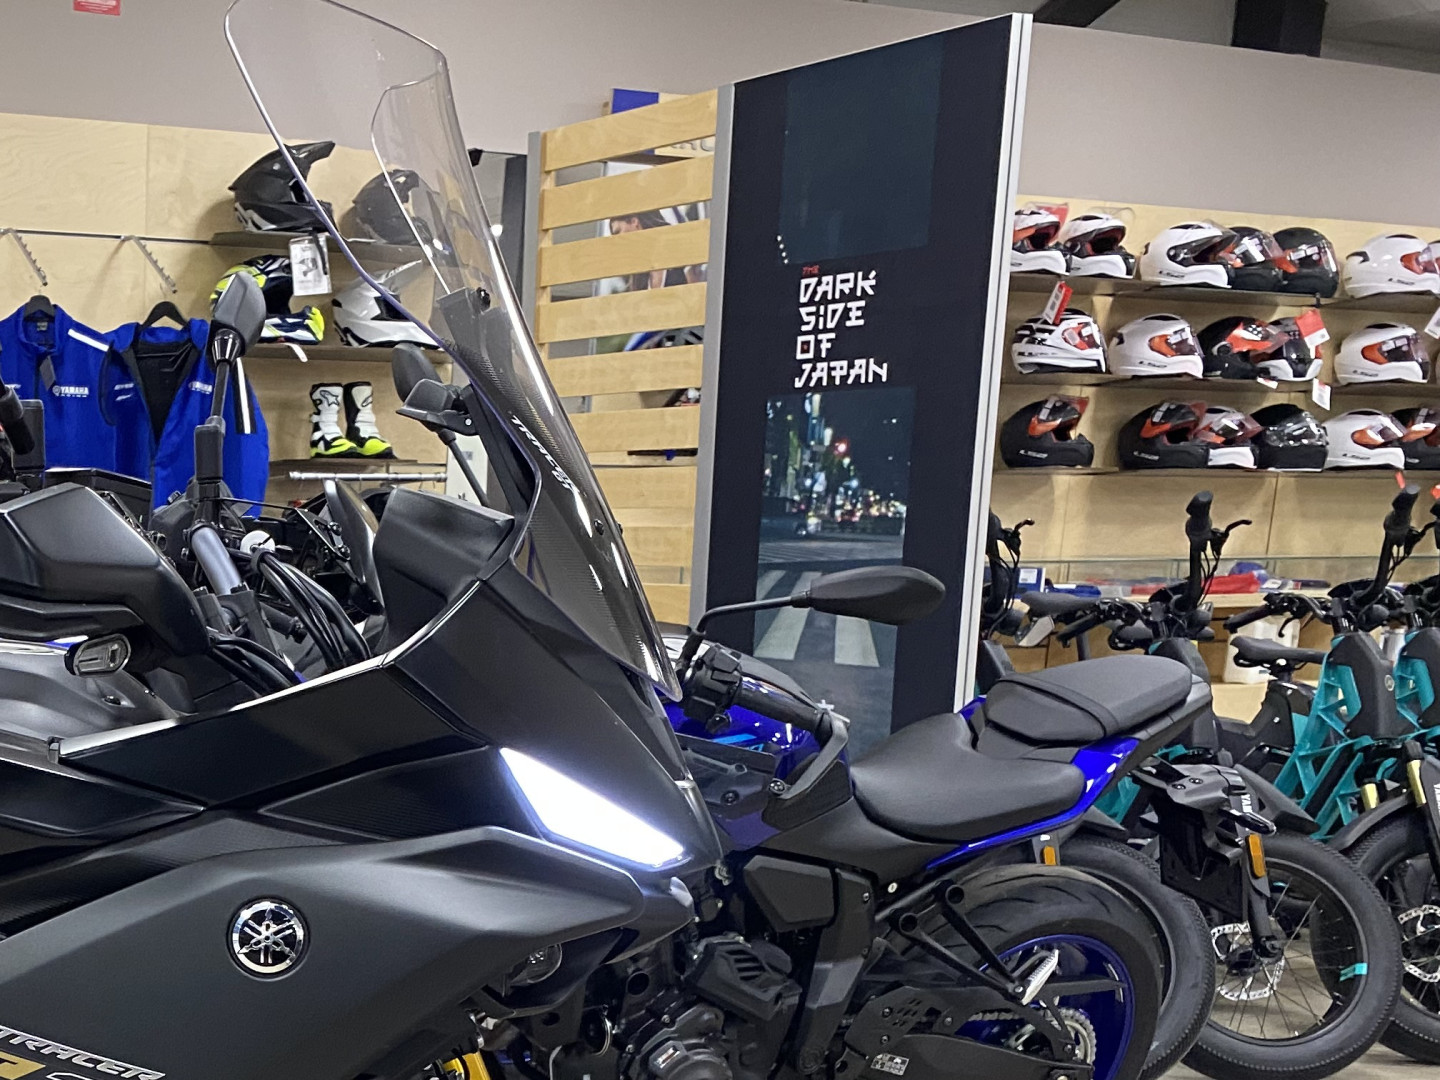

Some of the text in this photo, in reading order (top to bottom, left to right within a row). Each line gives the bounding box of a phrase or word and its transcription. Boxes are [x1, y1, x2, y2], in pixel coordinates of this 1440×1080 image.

[799, 270, 877, 303] DARK
[798, 300, 866, 331] SIDE
[796, 332, 836, 360] OF
[794, 358, 888, 388] JAPAN
